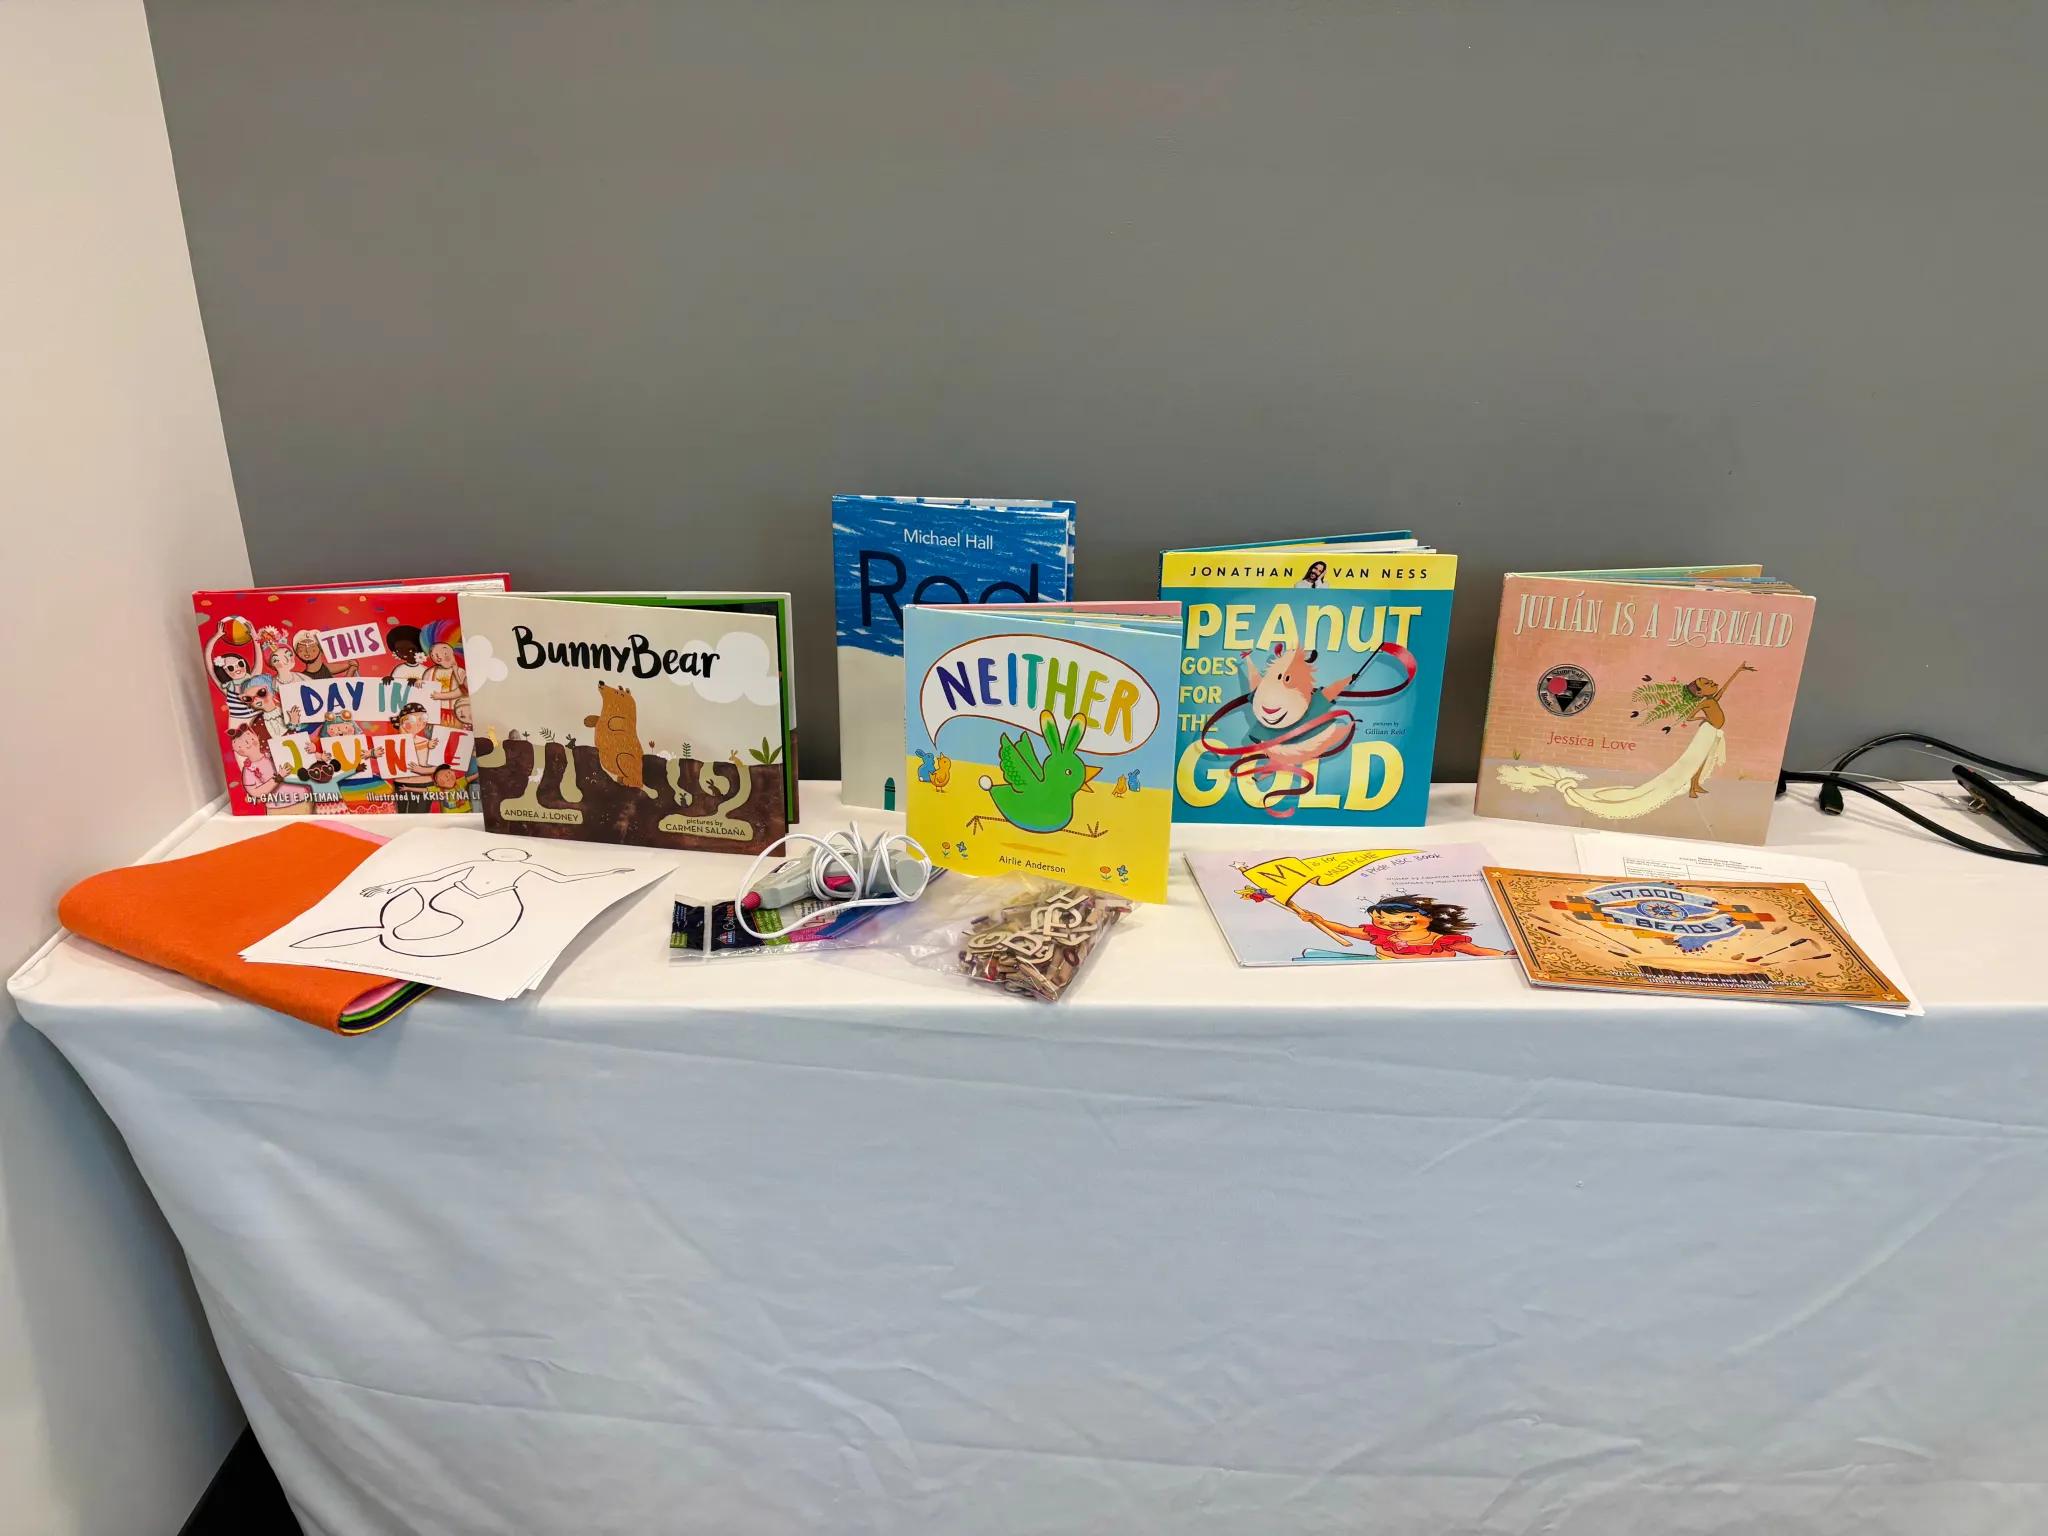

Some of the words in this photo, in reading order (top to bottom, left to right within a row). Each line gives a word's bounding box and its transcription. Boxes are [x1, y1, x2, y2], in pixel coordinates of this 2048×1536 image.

[903, 528, 960, 547] Michael
[965, 533, 993, 550] Hall
[1190, 566, 1294, 578] JONATHAN
[1333, 567, 1369, 579] VAN
[1381, 568, 1428, 579] NESS
[1513, 591, 1602, 636] JULIÁN
[1609, 600, 1637, 637] IS
[1640, 600, 1660, 639] A
[1666, 606, 1794, 649] MERMAID
[322, 625, 382, 660] THIS
[512, 625, 720, 679] BunnyBear
[1181, 656, 1238, 675] GOES
[300, 681, 364, 716] DAY
[378, 682, 416, 713] IN
[936, 653, 1140, 744] NEITHER
[1179, 685, 1222, 704] FOR
[1546, 731, 1594, 748] Jessica
[1602, 737, 1637, 751] Love
[282, 731, 469, 777] JUNE
[1176, 738, 1404, 811] GOLD
[246, 793, 257, 805] by
[260, 793, 290, 803] GAYLE
[293, 792, 302, 803] E.
[304, 792, 339, 802] PITMAN
[366, 792, 408, 802] illustrated
[410, 791, 420, 803] by
[423, 791, 469, 801] KRISTYNA
[504, 809, 539, 819] ANDREA
[541, 812, 548, 821] J.
[549, 812, 578, 823] LONEY
[686, 818, 713, 827] pictures
[714, 819, 723, 828] by
[665, 823, 702, 834] CARMEN
[704, 826, 746, 837] SALDAÑA
[999, 855, 1022, 867] Airlie
[1025, 859, 1066, 874] Anderson
[1324, 852, 1377, 878] MUSTACHE
[1257, 864, 1307, 887] M
[1635, 917, 1723, 934] BEADS
